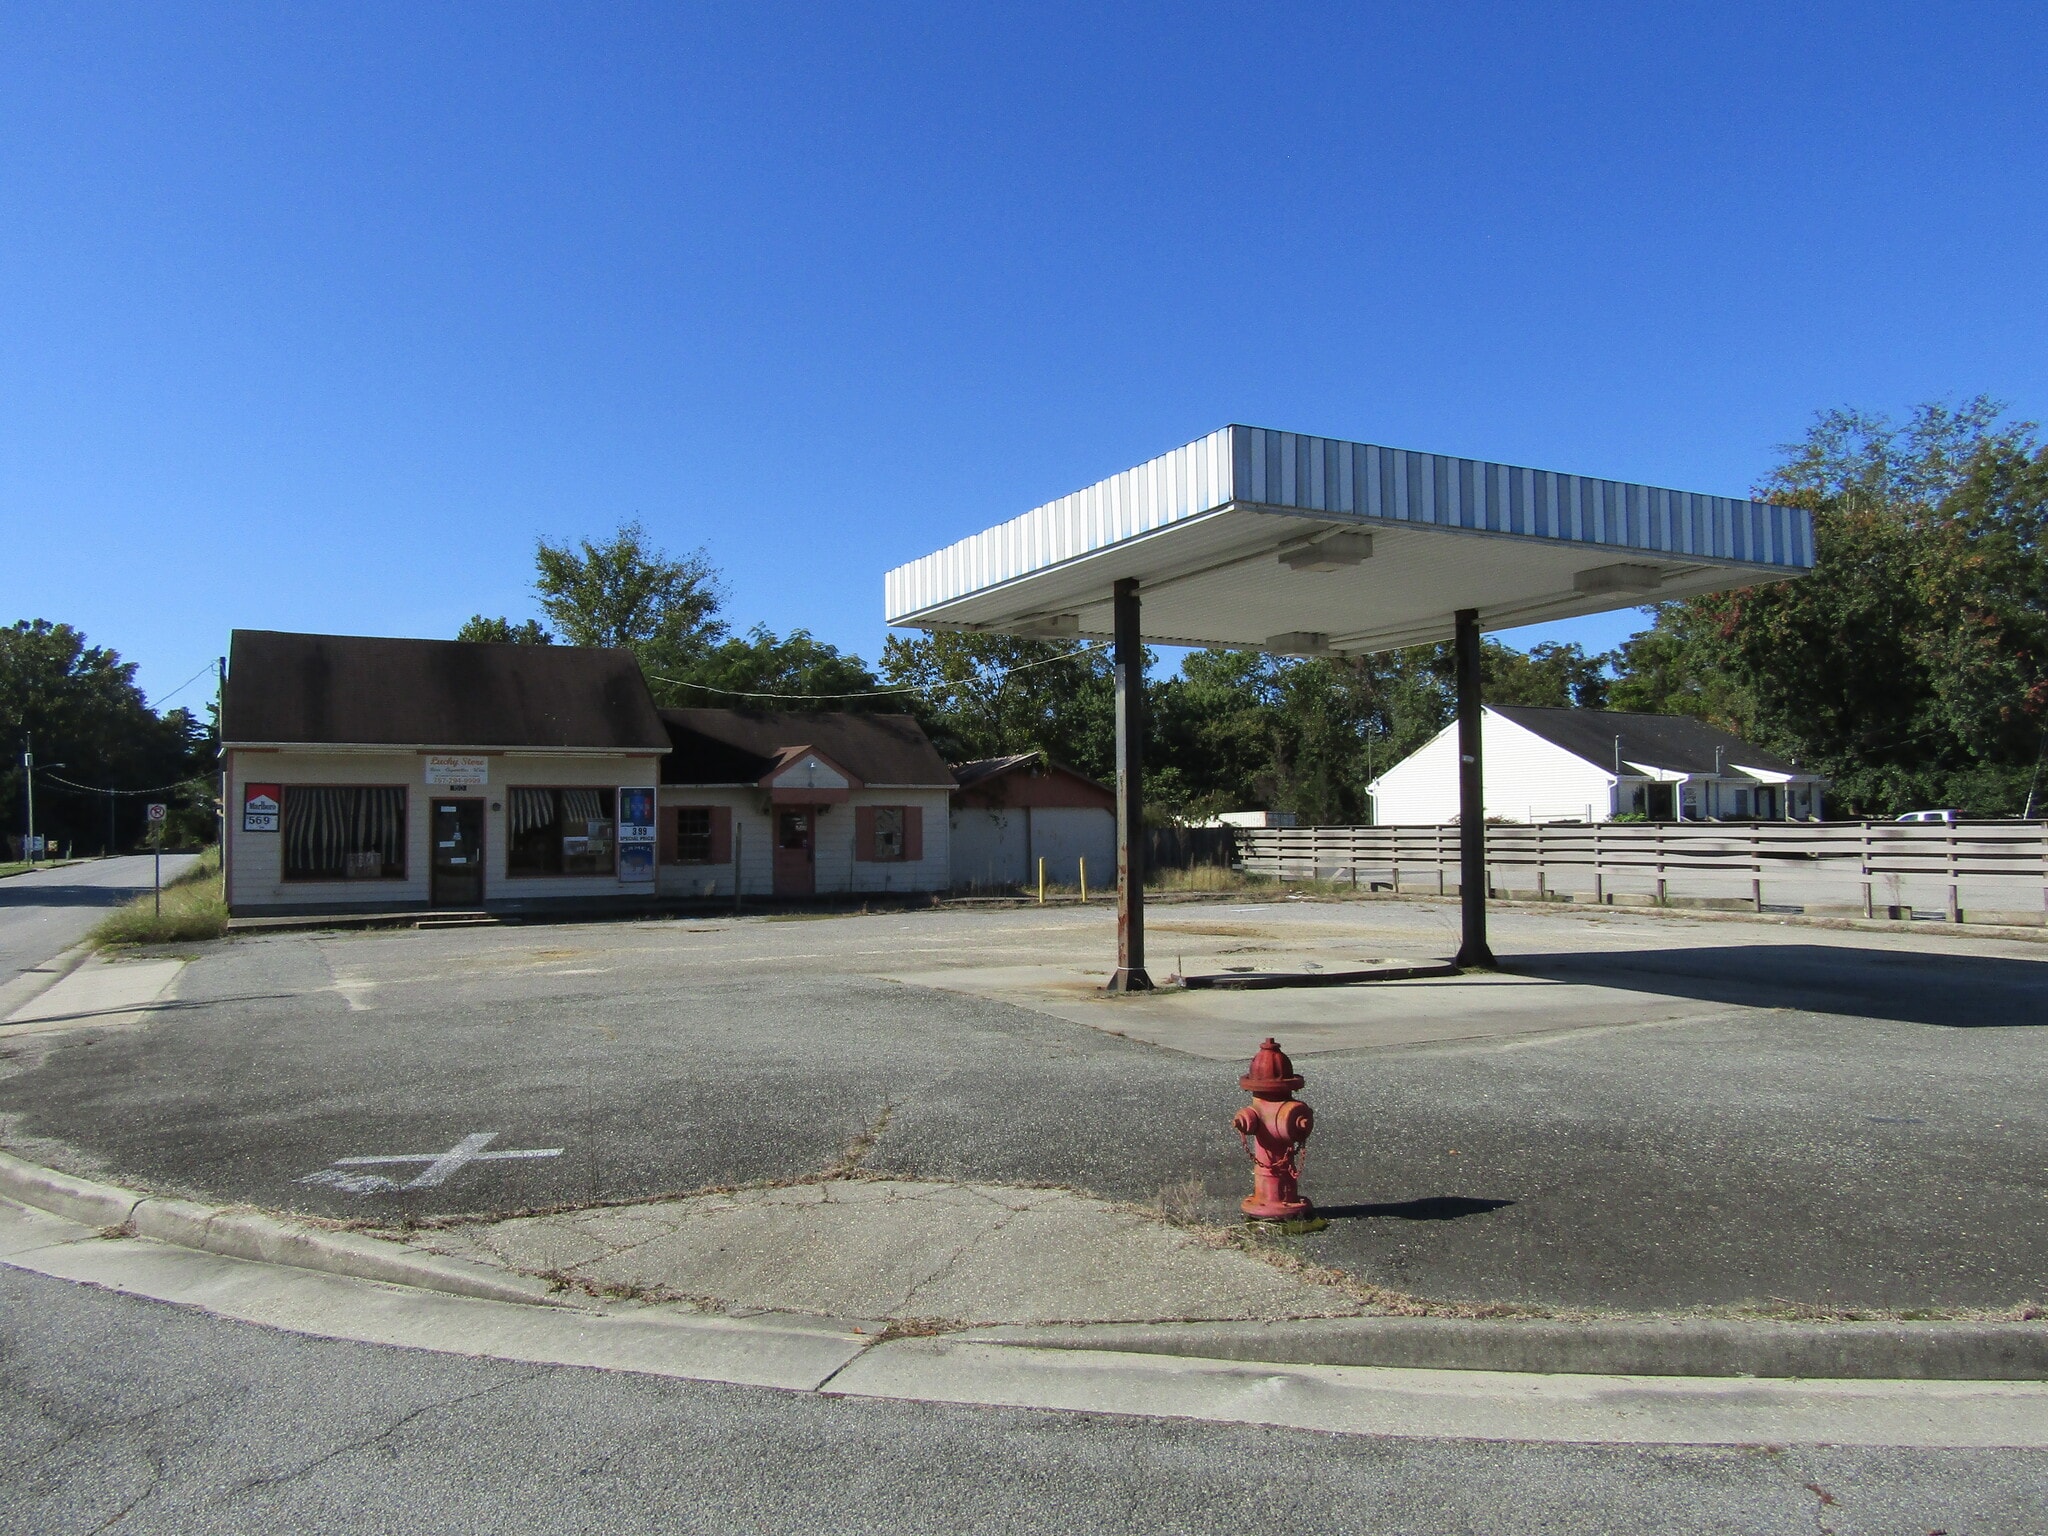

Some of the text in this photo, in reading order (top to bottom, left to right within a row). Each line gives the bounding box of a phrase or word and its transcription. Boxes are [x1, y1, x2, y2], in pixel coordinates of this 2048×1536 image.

[431, 757, 484, 767] Lucky Store
[249, 801, 277, 810] Marlboro
[621, 845, 652, 853] CAMEL
